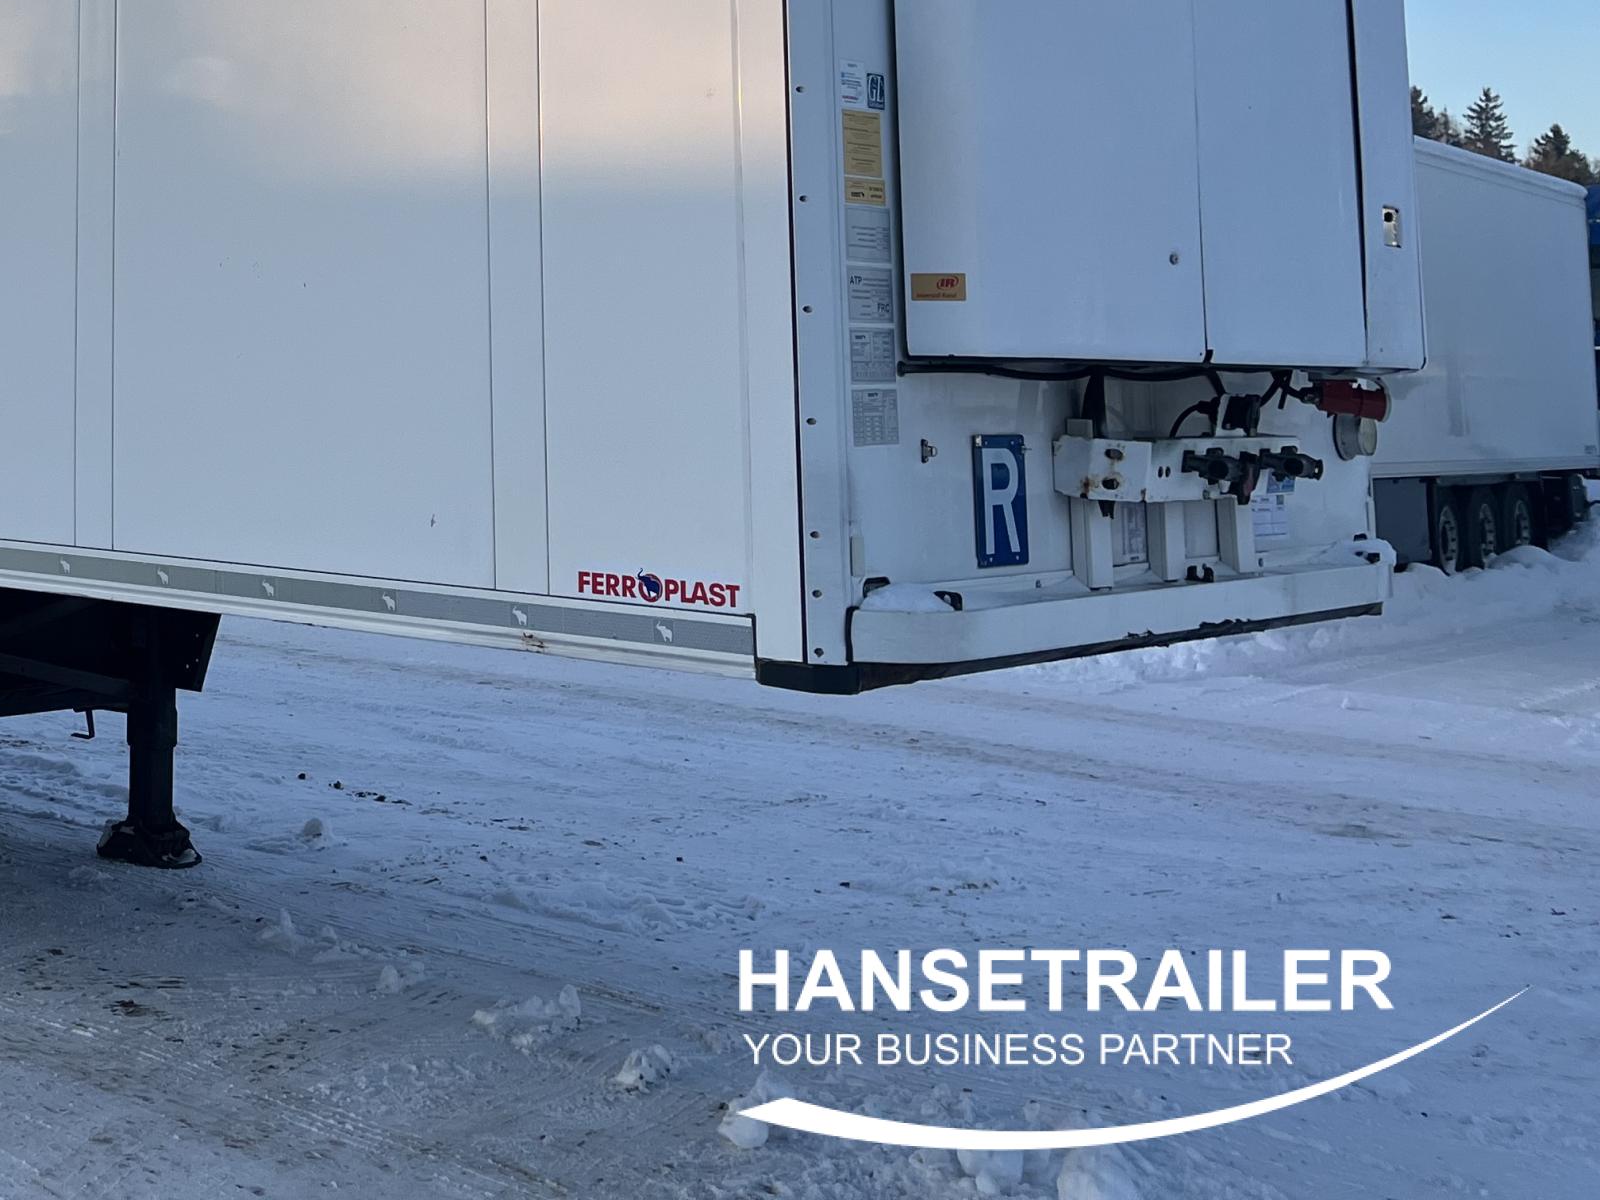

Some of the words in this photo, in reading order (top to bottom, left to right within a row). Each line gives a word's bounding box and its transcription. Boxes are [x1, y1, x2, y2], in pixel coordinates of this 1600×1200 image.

[849, 275, 863, 285] ATP
[981, 447, 1021, 555] R
[578, 568, 740, 608] FERROPLAST
